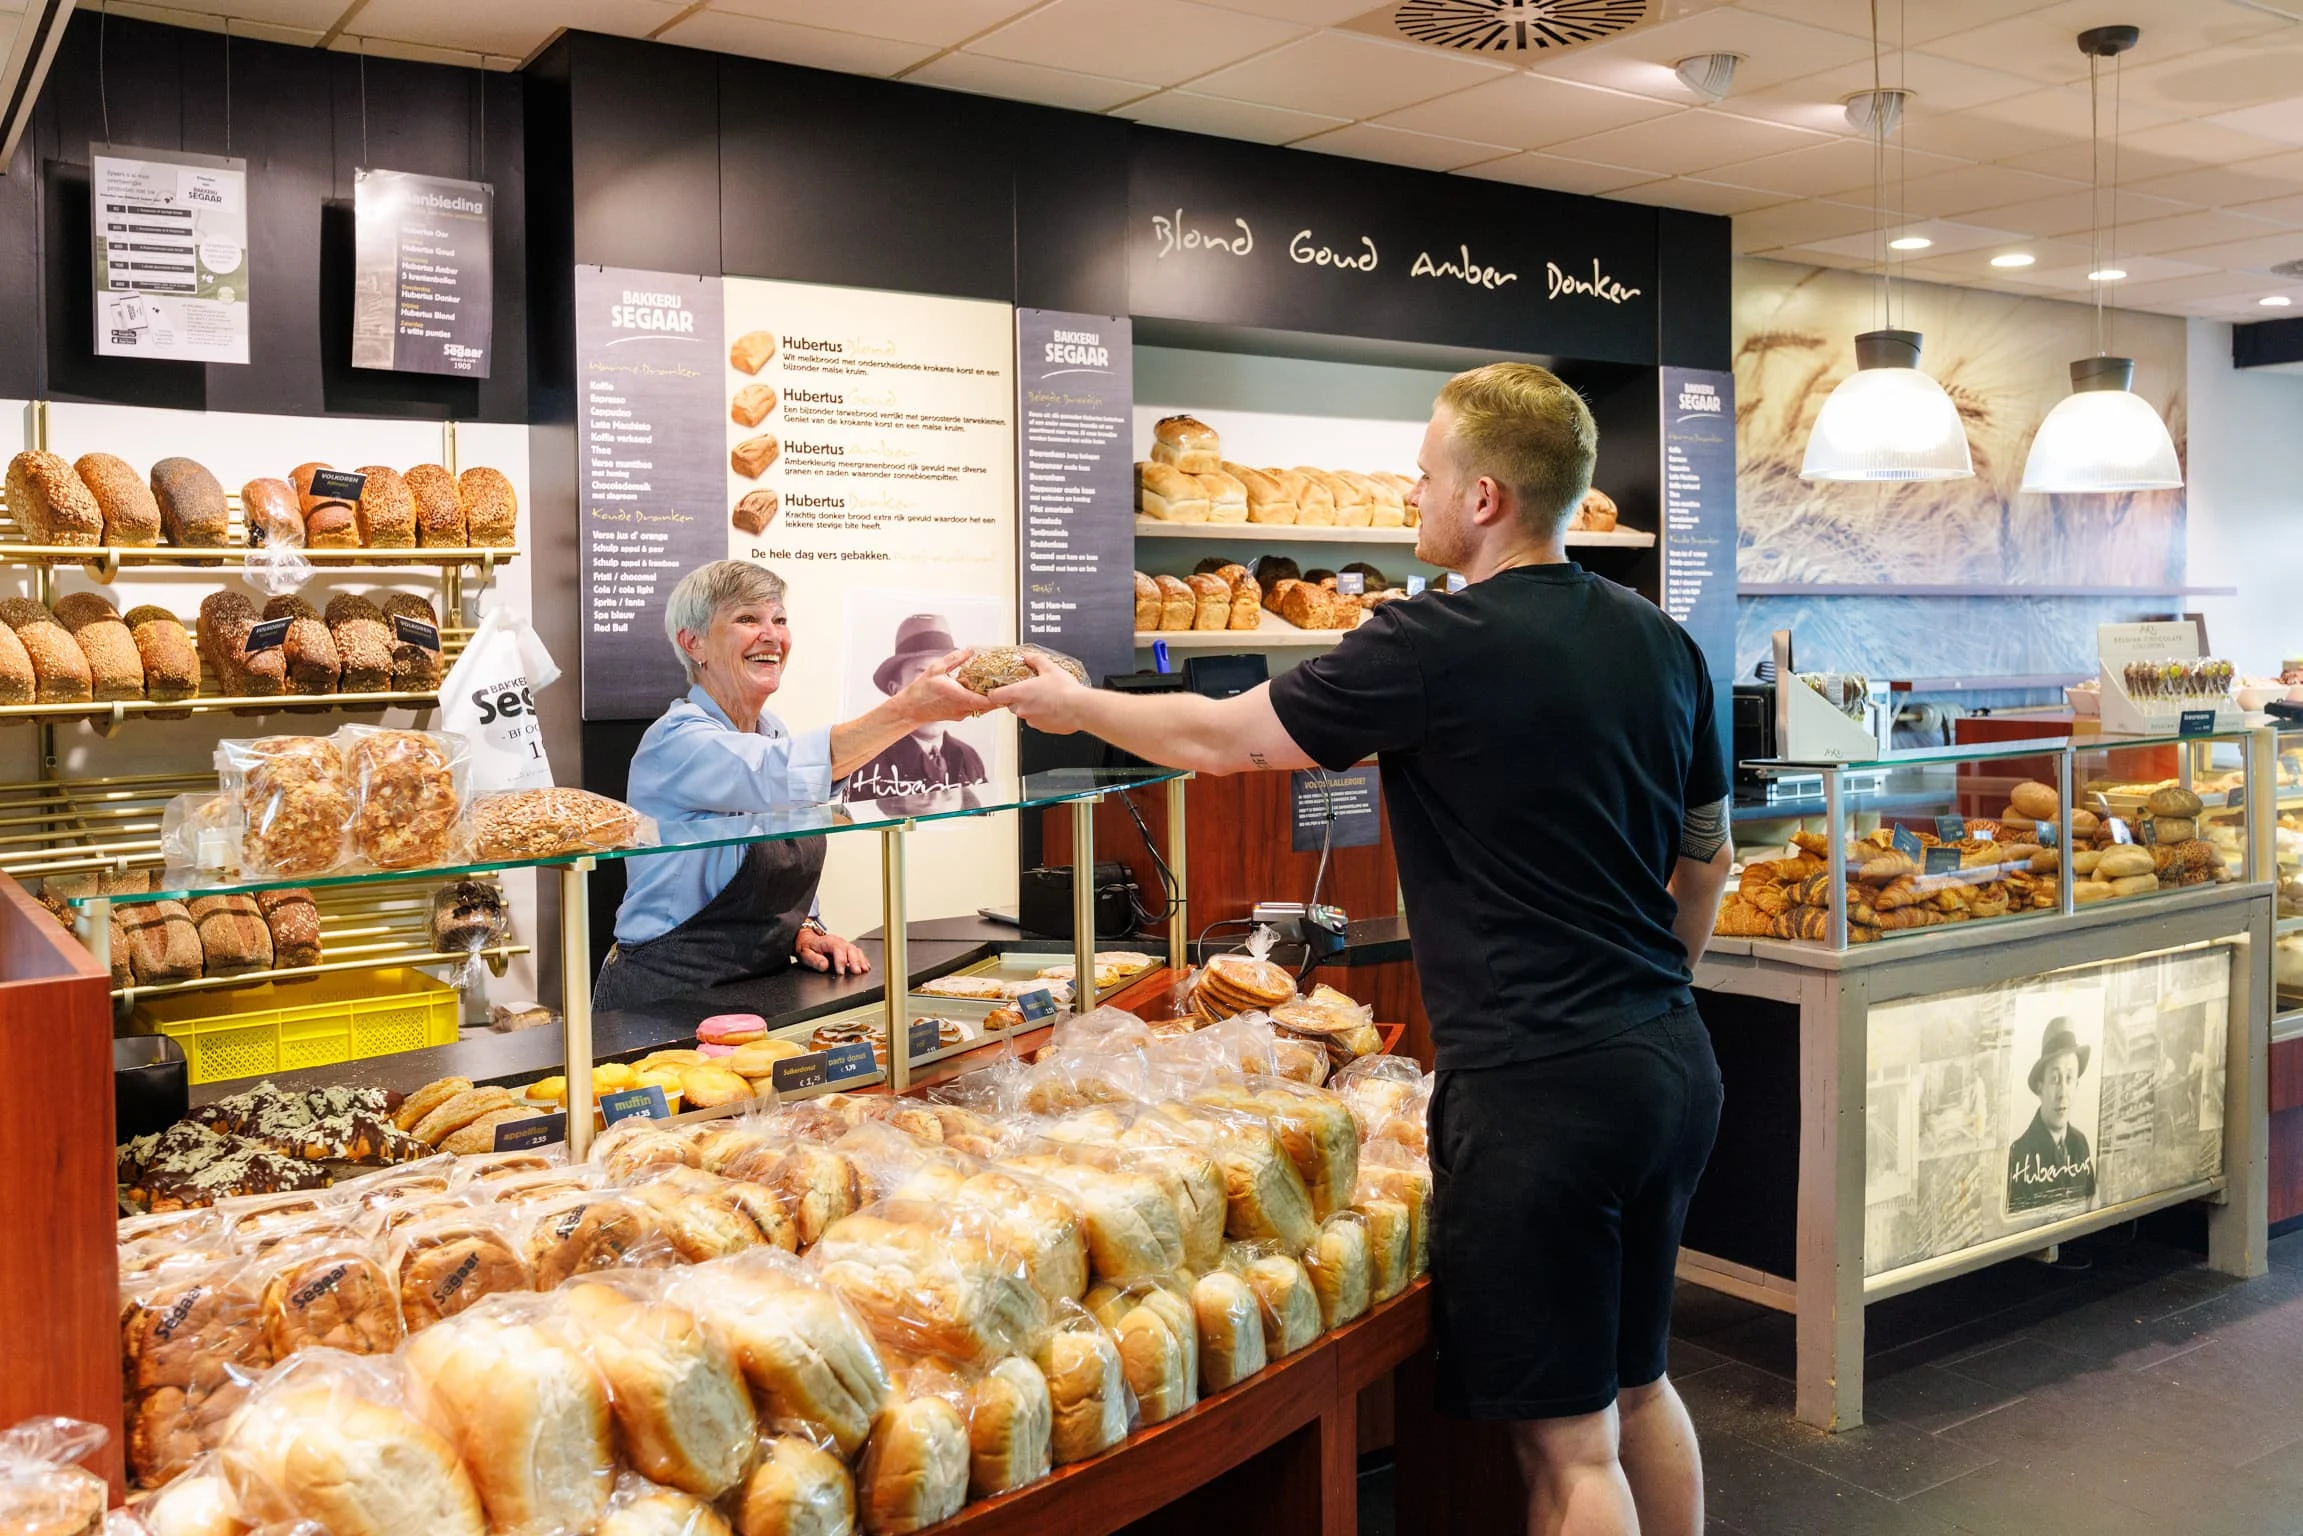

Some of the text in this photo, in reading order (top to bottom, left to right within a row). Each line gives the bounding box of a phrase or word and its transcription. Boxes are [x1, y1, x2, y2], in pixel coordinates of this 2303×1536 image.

[188, 191, 223, 204] SEGAAR
[1152, 208, 1641, 304] Blond Goud Amber Donker
[401, 261, 434, 273] Hubertus
[401, 290, 461, 304] Hubertus Donker
[622, 290, 682, 309] BAKKERIJ
[400, 308, 456, 321] Hubertus Blond
[611, 304, 695, 333] SEGAAR
[782, 335, 843, 354] Hubertus
[1053, 329, 1100, 346] BAKKERIJ
[443, 343, 484, 359] Segaar
[1044, 342, 1109, 367] SEGAAR
[783, 352, 1000, 377] Wit melkbrood met onderscheidende krokante korst en een
[783, 362, 820, 374] bijzonder
[589, 380, 615, 392] Koffie
[590, 393, 627, 405] Espresso
[783, 387, 844, 405] Hubertus
[1679, 393, 1722, 412] SEGAAR
[783, 404, 798, 414] Een
[799, 406, 835, 417] bijzonder
[836, 408, 878, 419] tarwebrood
[905, 413, 919, 421] met
[783, 414, 810, 424] Geniet
[811, 417, 826, 425] van
[826, 417, 839, 425] de
[839, 418, 874, 428] krokante
[874, 420, 894, 429] korst
[905, 422, 921, 430] een
[590, 432, 615, 443] Koffie
[590, 445, 612, 456] Thee
[784, 439, 845, 456] Hubertus
[591, 457, 614, 468] Verse
[784, 457, 988, 475] Amberkleurig meergranenbrood rijk gevuld met diverse
[320, 472, 359, 484] VOLKOREN
[784, 467, 813, 477] granen
[825, 469, 850, 478] zaden
[851, 470, 892, 480] waaronder
[784, 492, 846, 508] Hubertus
[591, 508, 695, 524] Koude Dranken
[785, 510, 997, 525] Krachtig donker brood extra rijk gevuld waardoor het een
[785, 520, 815, 529] lekkere
[815, 520, 843, 530] stevige
[844, 520, 860, 530] bite
[592, 530, 615, 540] Verse
[640, 533, 669, 542] orange
[592, 543, 619, 554] Schulp
[751, 548, 767, 559] De
[769, 547, 793, 560] hele
[794, 548, 815, 563] dag
[817, 552, 839, 560] vers
[840, 549, 892, 562] gebakken.
[592, 557, 619, 568] Schulp
[593, 584, 655, 596] Cola cola light
[593, 597, 646, 609] Sprite fanta
[593, 610, 636, 621] Spa blauw
[593, 622, 629, 633] Red Bull
[614, 1094, 653, 1113] muffin
[431, 1250, 481, 1305] Segaar
[291, 1262, 349, 1312] Segaar
[154, 1282, 202, 1342] Segaar
